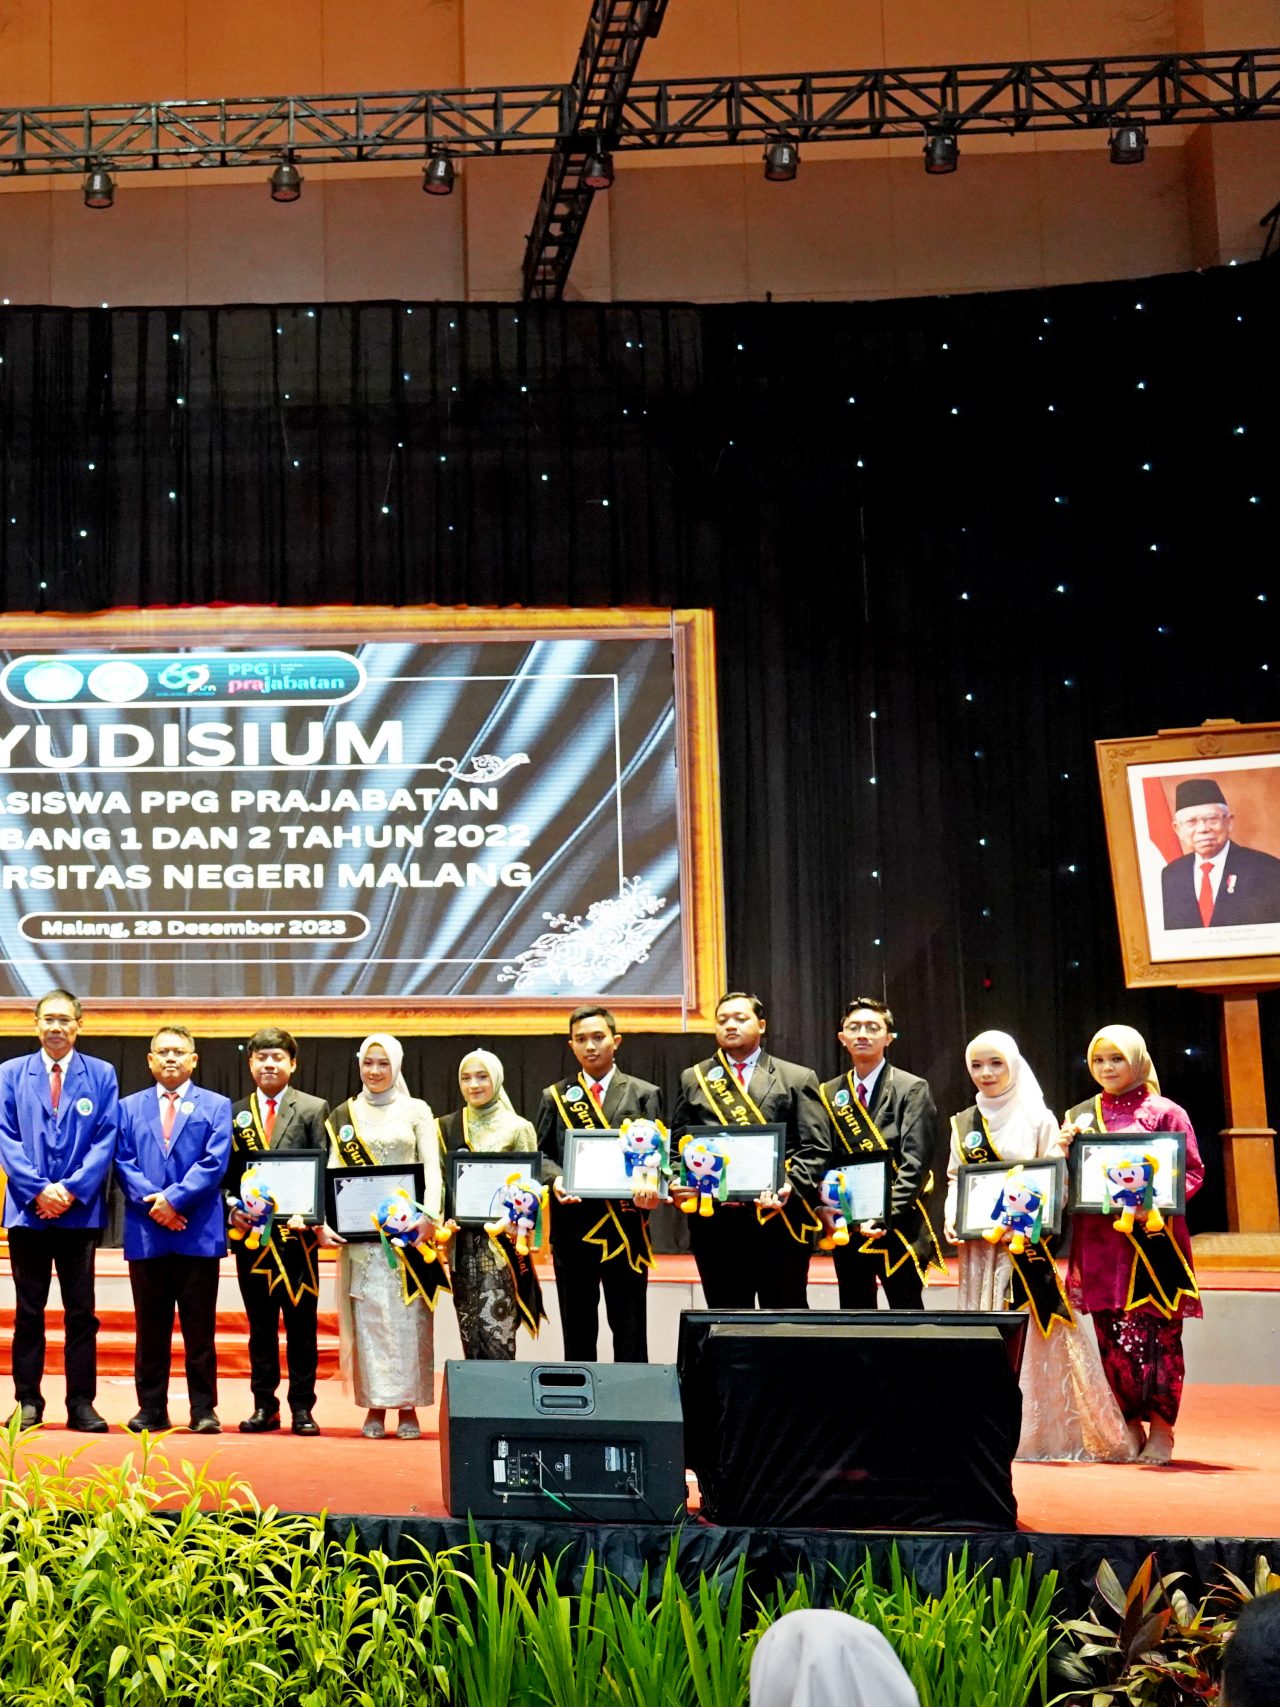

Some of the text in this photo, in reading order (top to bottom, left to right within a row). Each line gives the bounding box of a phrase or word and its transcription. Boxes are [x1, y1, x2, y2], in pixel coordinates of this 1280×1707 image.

[227, 662, 269, 676] PPG
[227, 675, 345, 694] prajabatan
[140, 790, 219, 814] PPG
[231, 788, 498, 813] PRAJABATAN
[120, 827, 142, 850] 1
[152, 826, 237, 850] DAN
[248, 826, 271, 849] 2
[279, 825, 424, 849] TAHUN
[434, 824, 531, 848] 2022
[163, 863, 324, 889] NEGERI
[338, 862, 532, 888] MALANG
[41, 919, 347, 938] Malang, 28 Desember 2023
[710, 1078, 735, 1105] Guru
[837, 1104, 862, 1136] Guru
[239, 1128, 259, 1151] Gur
[344, 1141, 367, 1166] Gur
